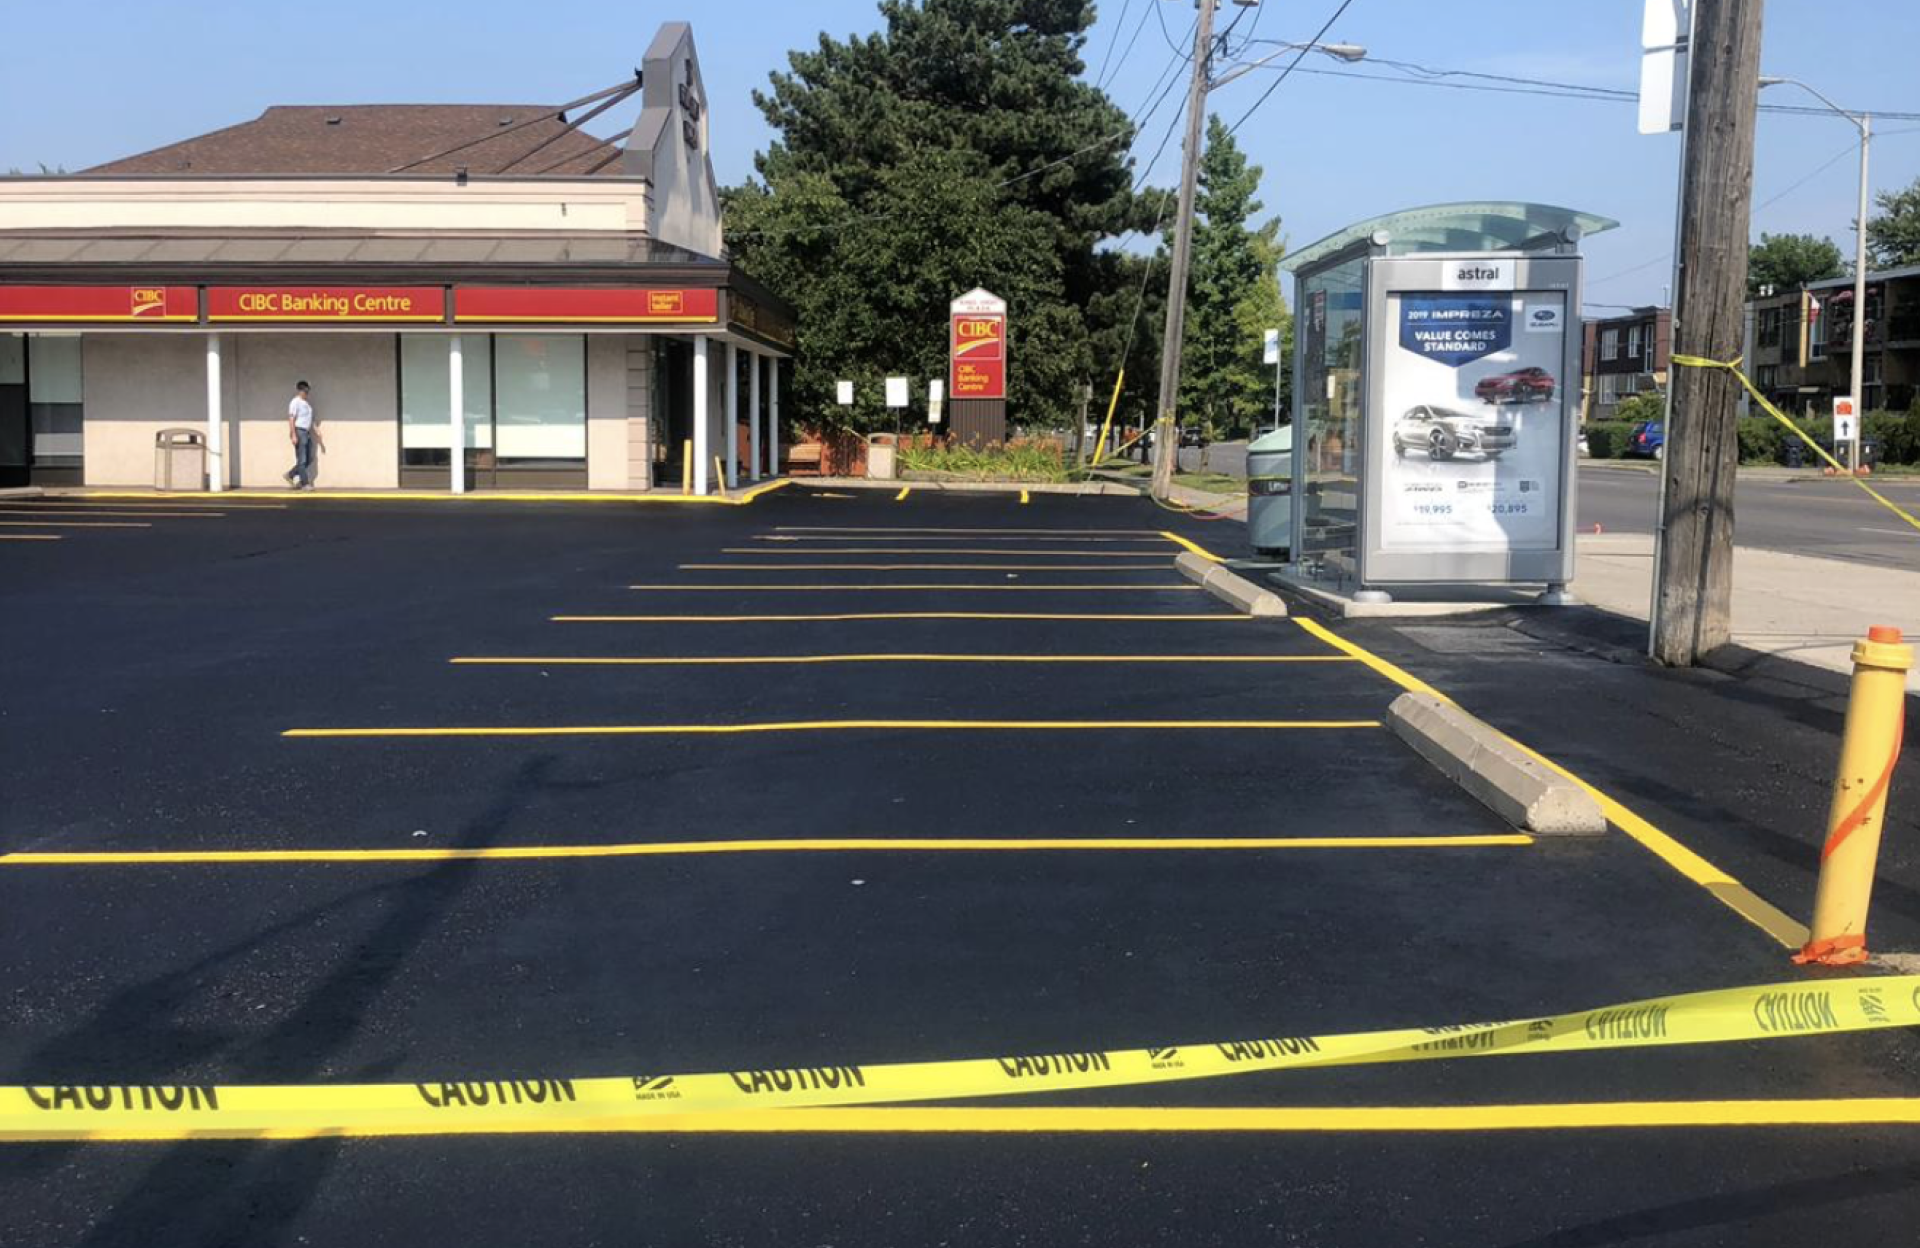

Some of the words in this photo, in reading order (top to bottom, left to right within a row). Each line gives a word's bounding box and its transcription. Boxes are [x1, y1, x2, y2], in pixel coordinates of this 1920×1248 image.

[1458, 267, 1499, 280] astral
[135, 290, 163, 302] CIBC
[239, 293, 278, 311] CIBC
[281, 293, 349, 316] Banking
[354, 293, 411, 311] Centre
[1432, 310, 1503, 319] IMPREZA
[958, 321, 999, 337] CIBC
[1415, 331, 1451, 341] VALUE
[1454, 330, 1496, 340] COMES
[1424, 341, 1487, 351] STANDARD
